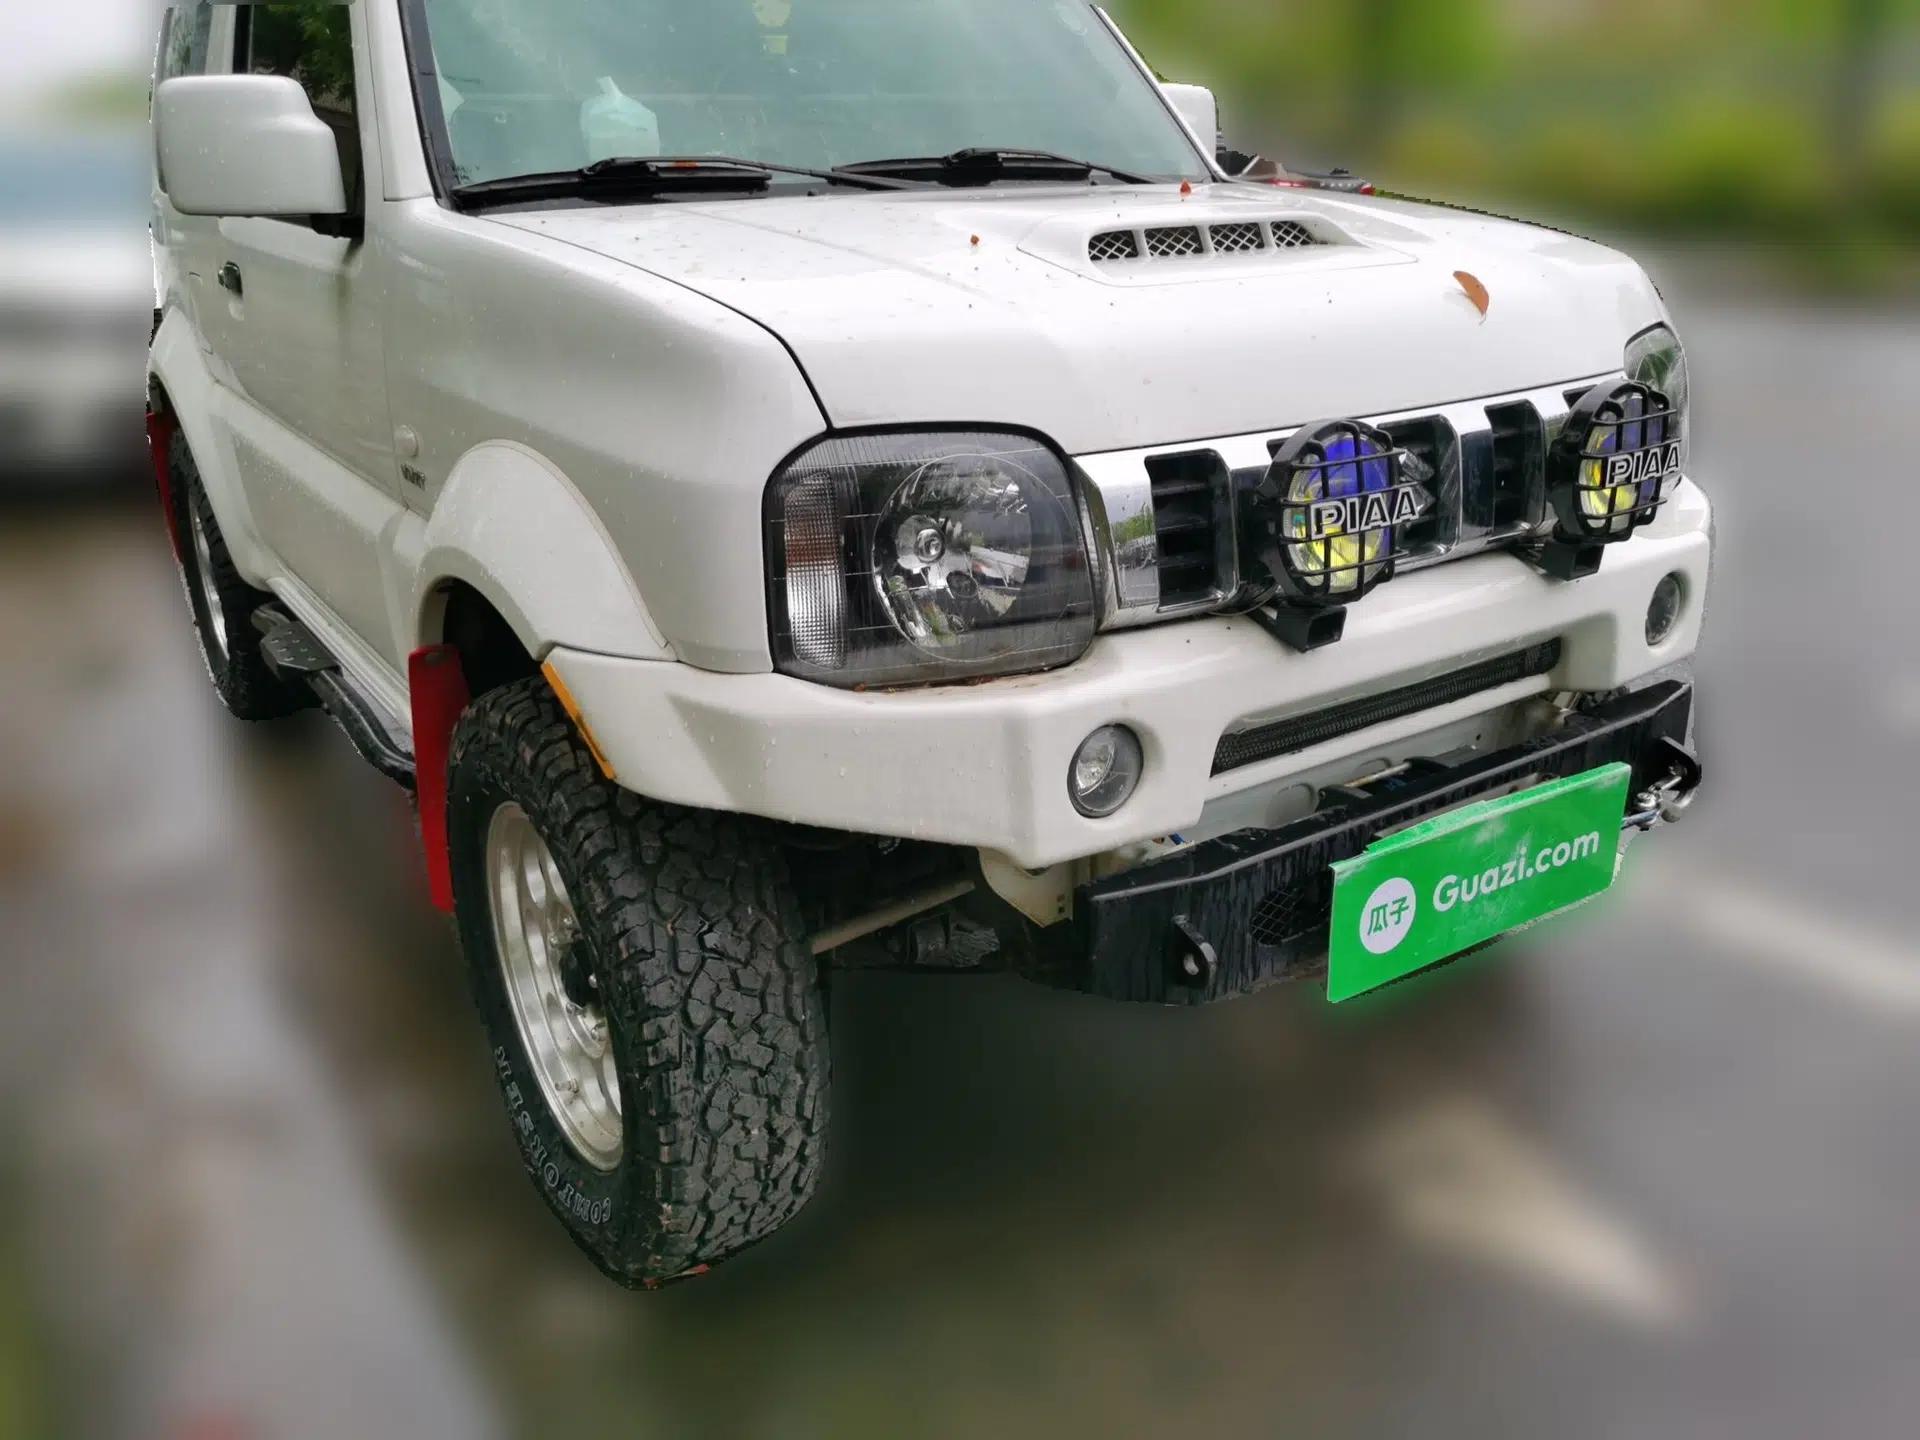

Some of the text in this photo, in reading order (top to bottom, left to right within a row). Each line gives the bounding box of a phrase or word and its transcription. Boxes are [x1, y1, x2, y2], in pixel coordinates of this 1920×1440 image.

[1607, 447, 1681, 488] PIAA
[1310, 486, 1419, 539] PIAA
[1432, 831, 1600, 912] Guazi.com
[1367, 895, 1410, 936] 瓜子
